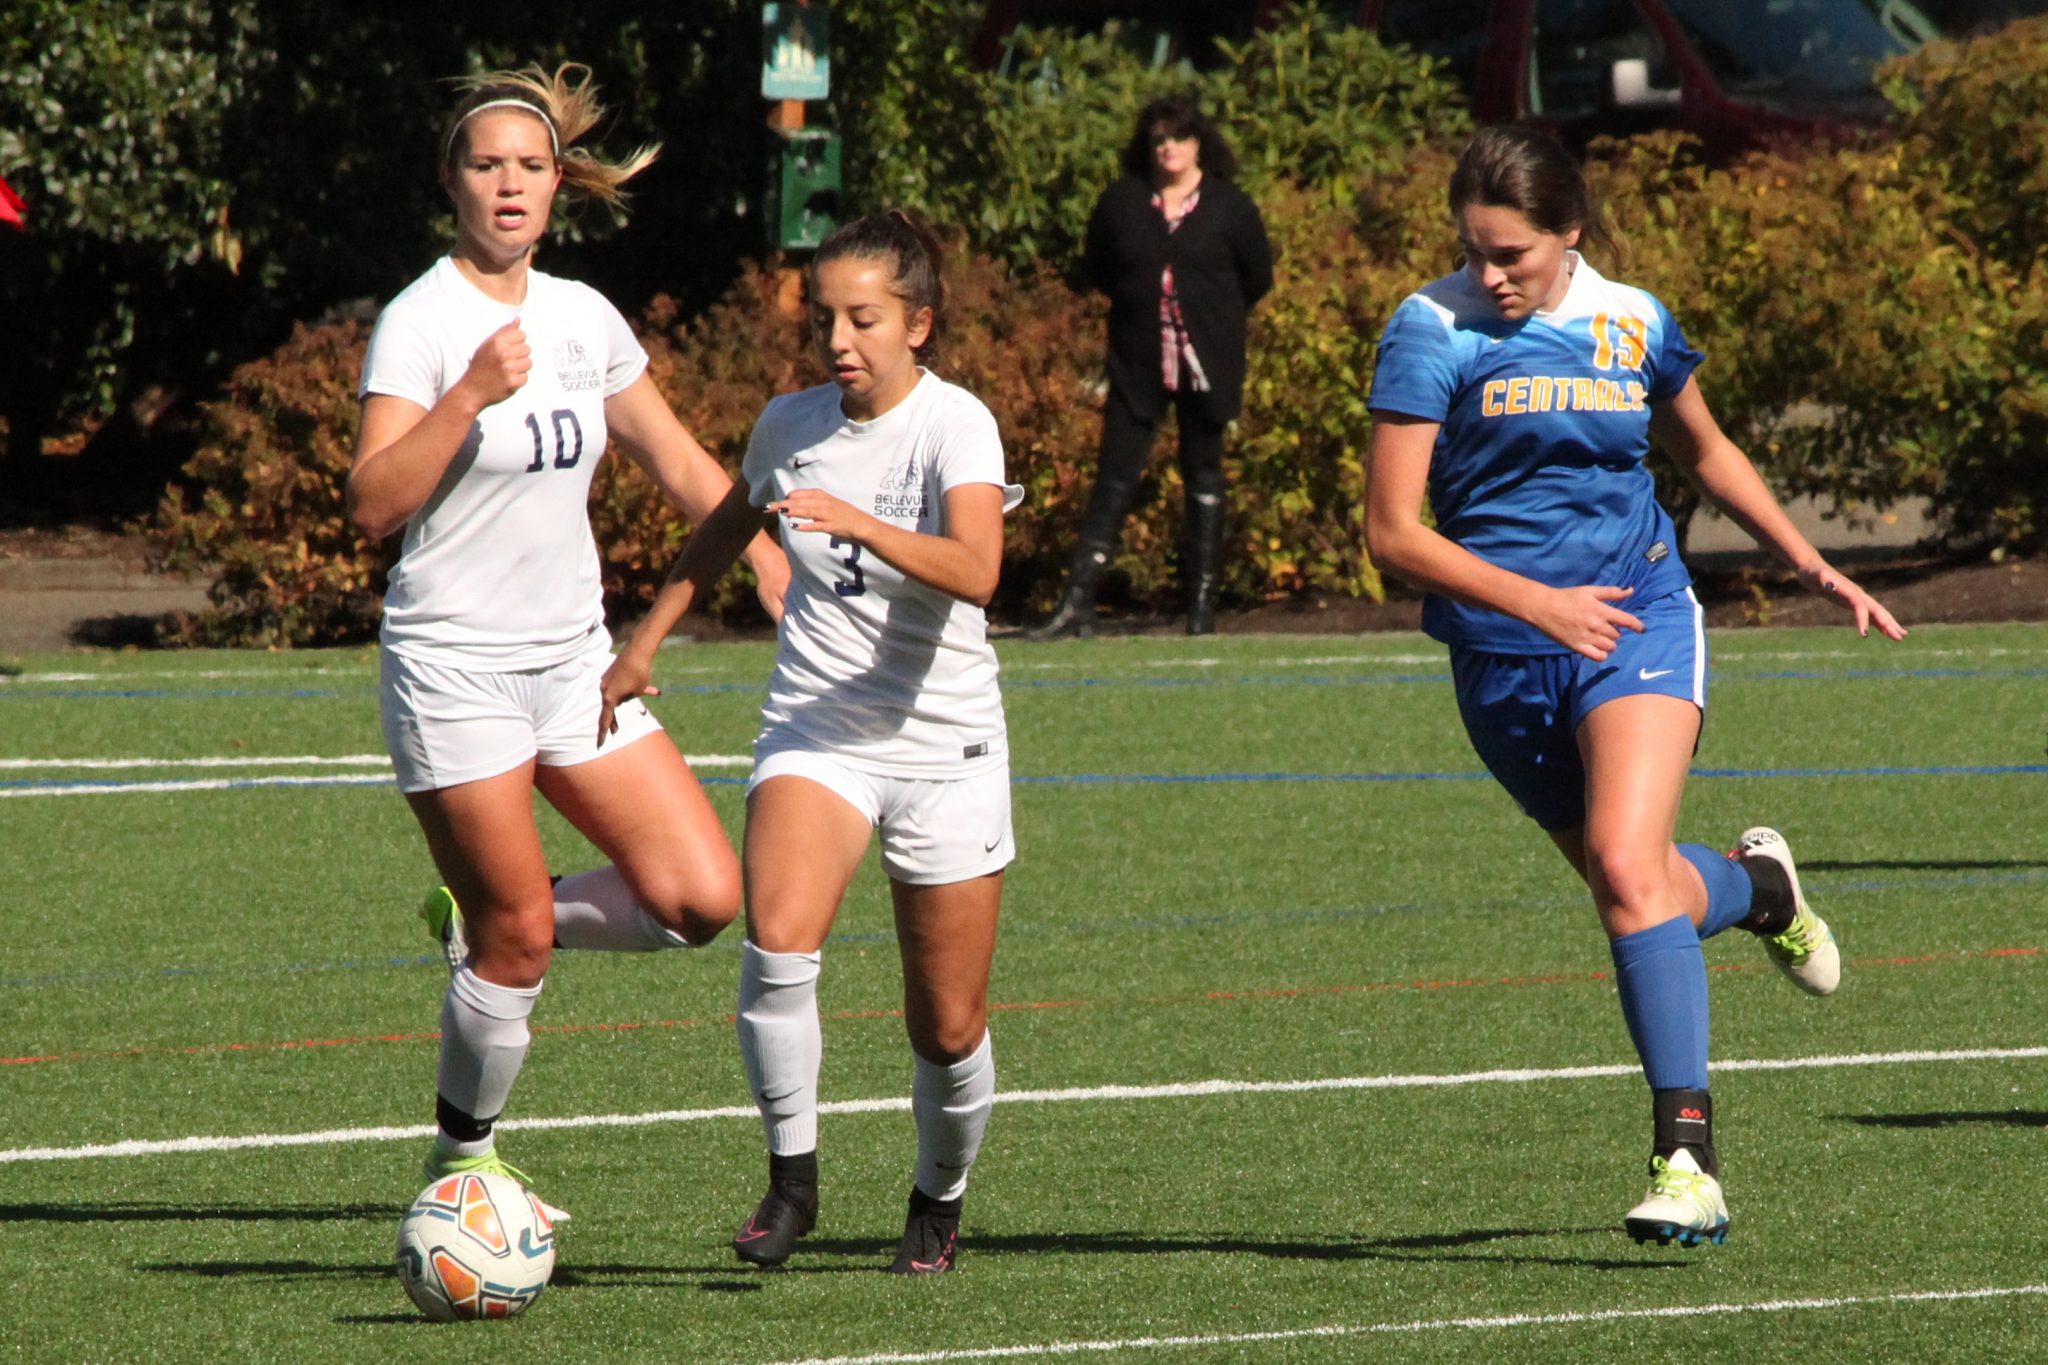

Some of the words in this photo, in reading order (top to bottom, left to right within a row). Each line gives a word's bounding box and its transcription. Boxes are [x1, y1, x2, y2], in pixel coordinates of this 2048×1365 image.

[1590, 311, 1647, 371] 13
[557, 369, 599, 381] BELLEVUE
[561, 379, 601, 392] SOCCER
[525, 408, 583, 473] 10
[874, 493, 929, 506] BELLEVUE
[873, 504, 929, 518] SOCCER
[829, 534, 867, 597] 3
